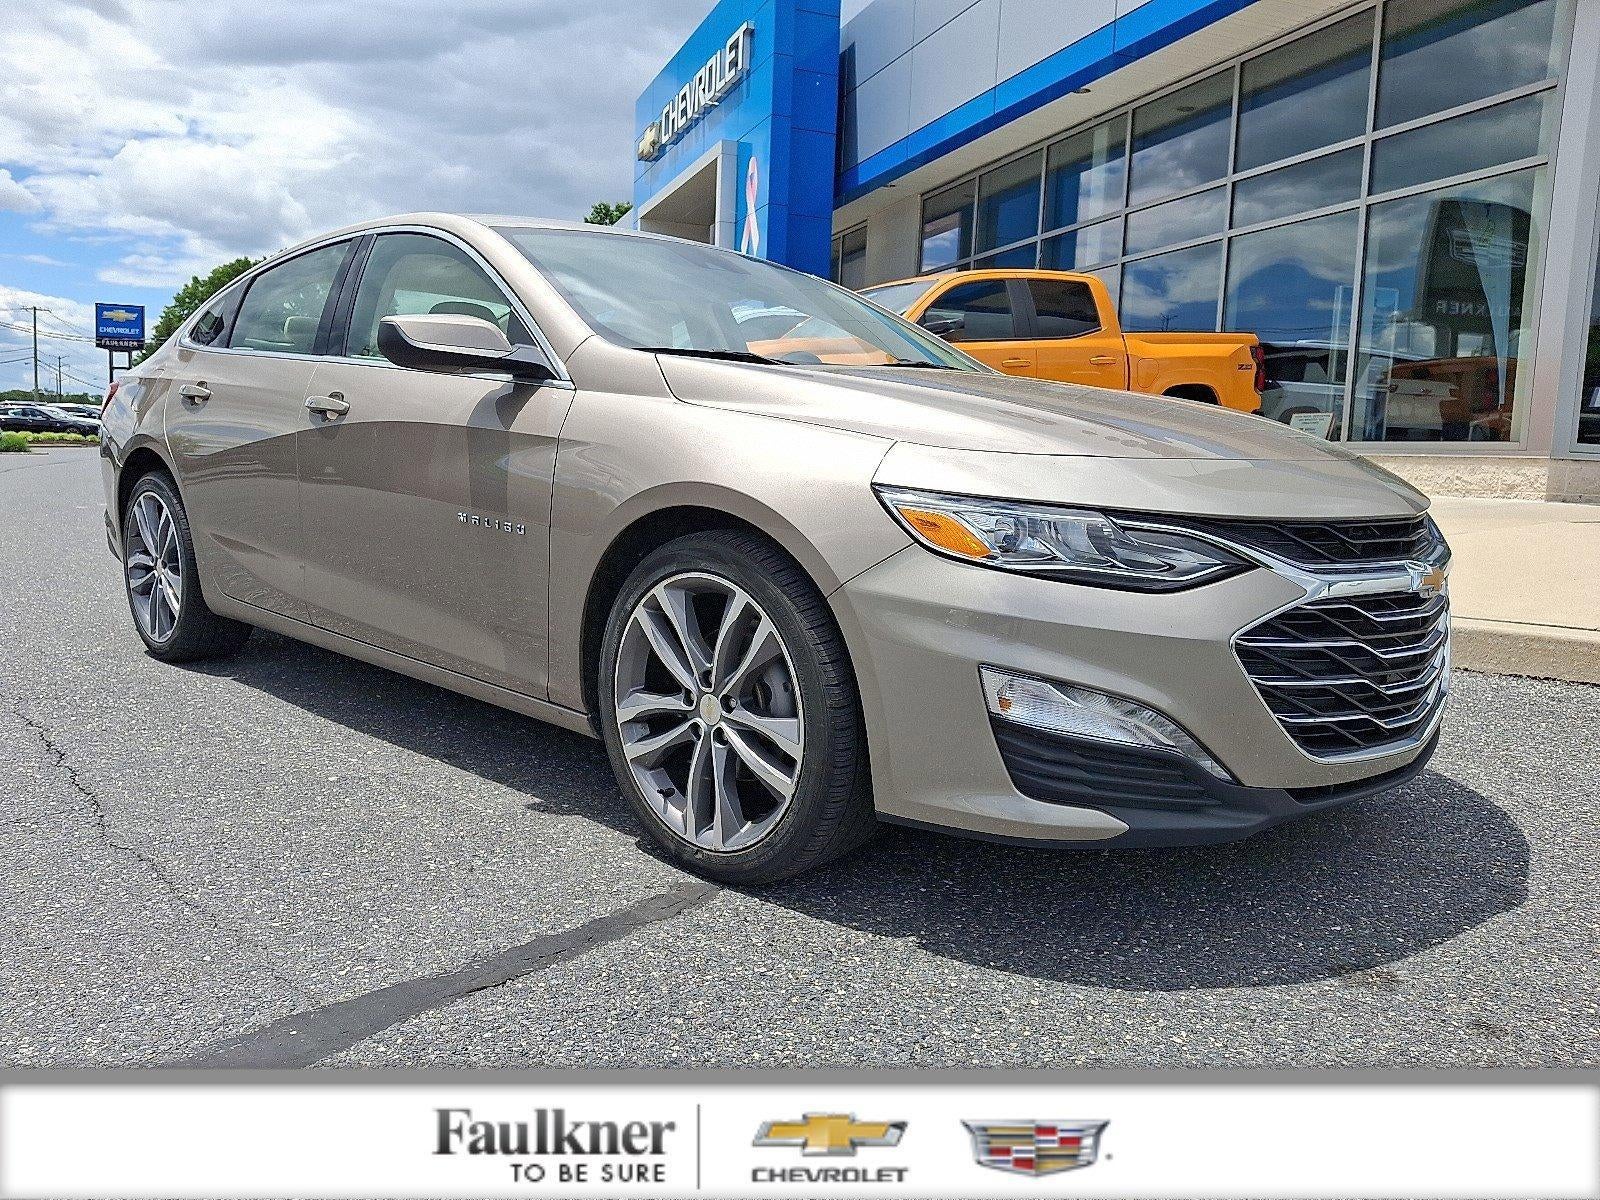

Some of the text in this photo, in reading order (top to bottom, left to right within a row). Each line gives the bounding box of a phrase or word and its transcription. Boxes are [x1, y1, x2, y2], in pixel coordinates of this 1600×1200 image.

[661, 20, 752, 145] CHEVROLET
[99, 327, 140, 335] CHEVROLET
[457, 512, 526, 536] MALIBU
